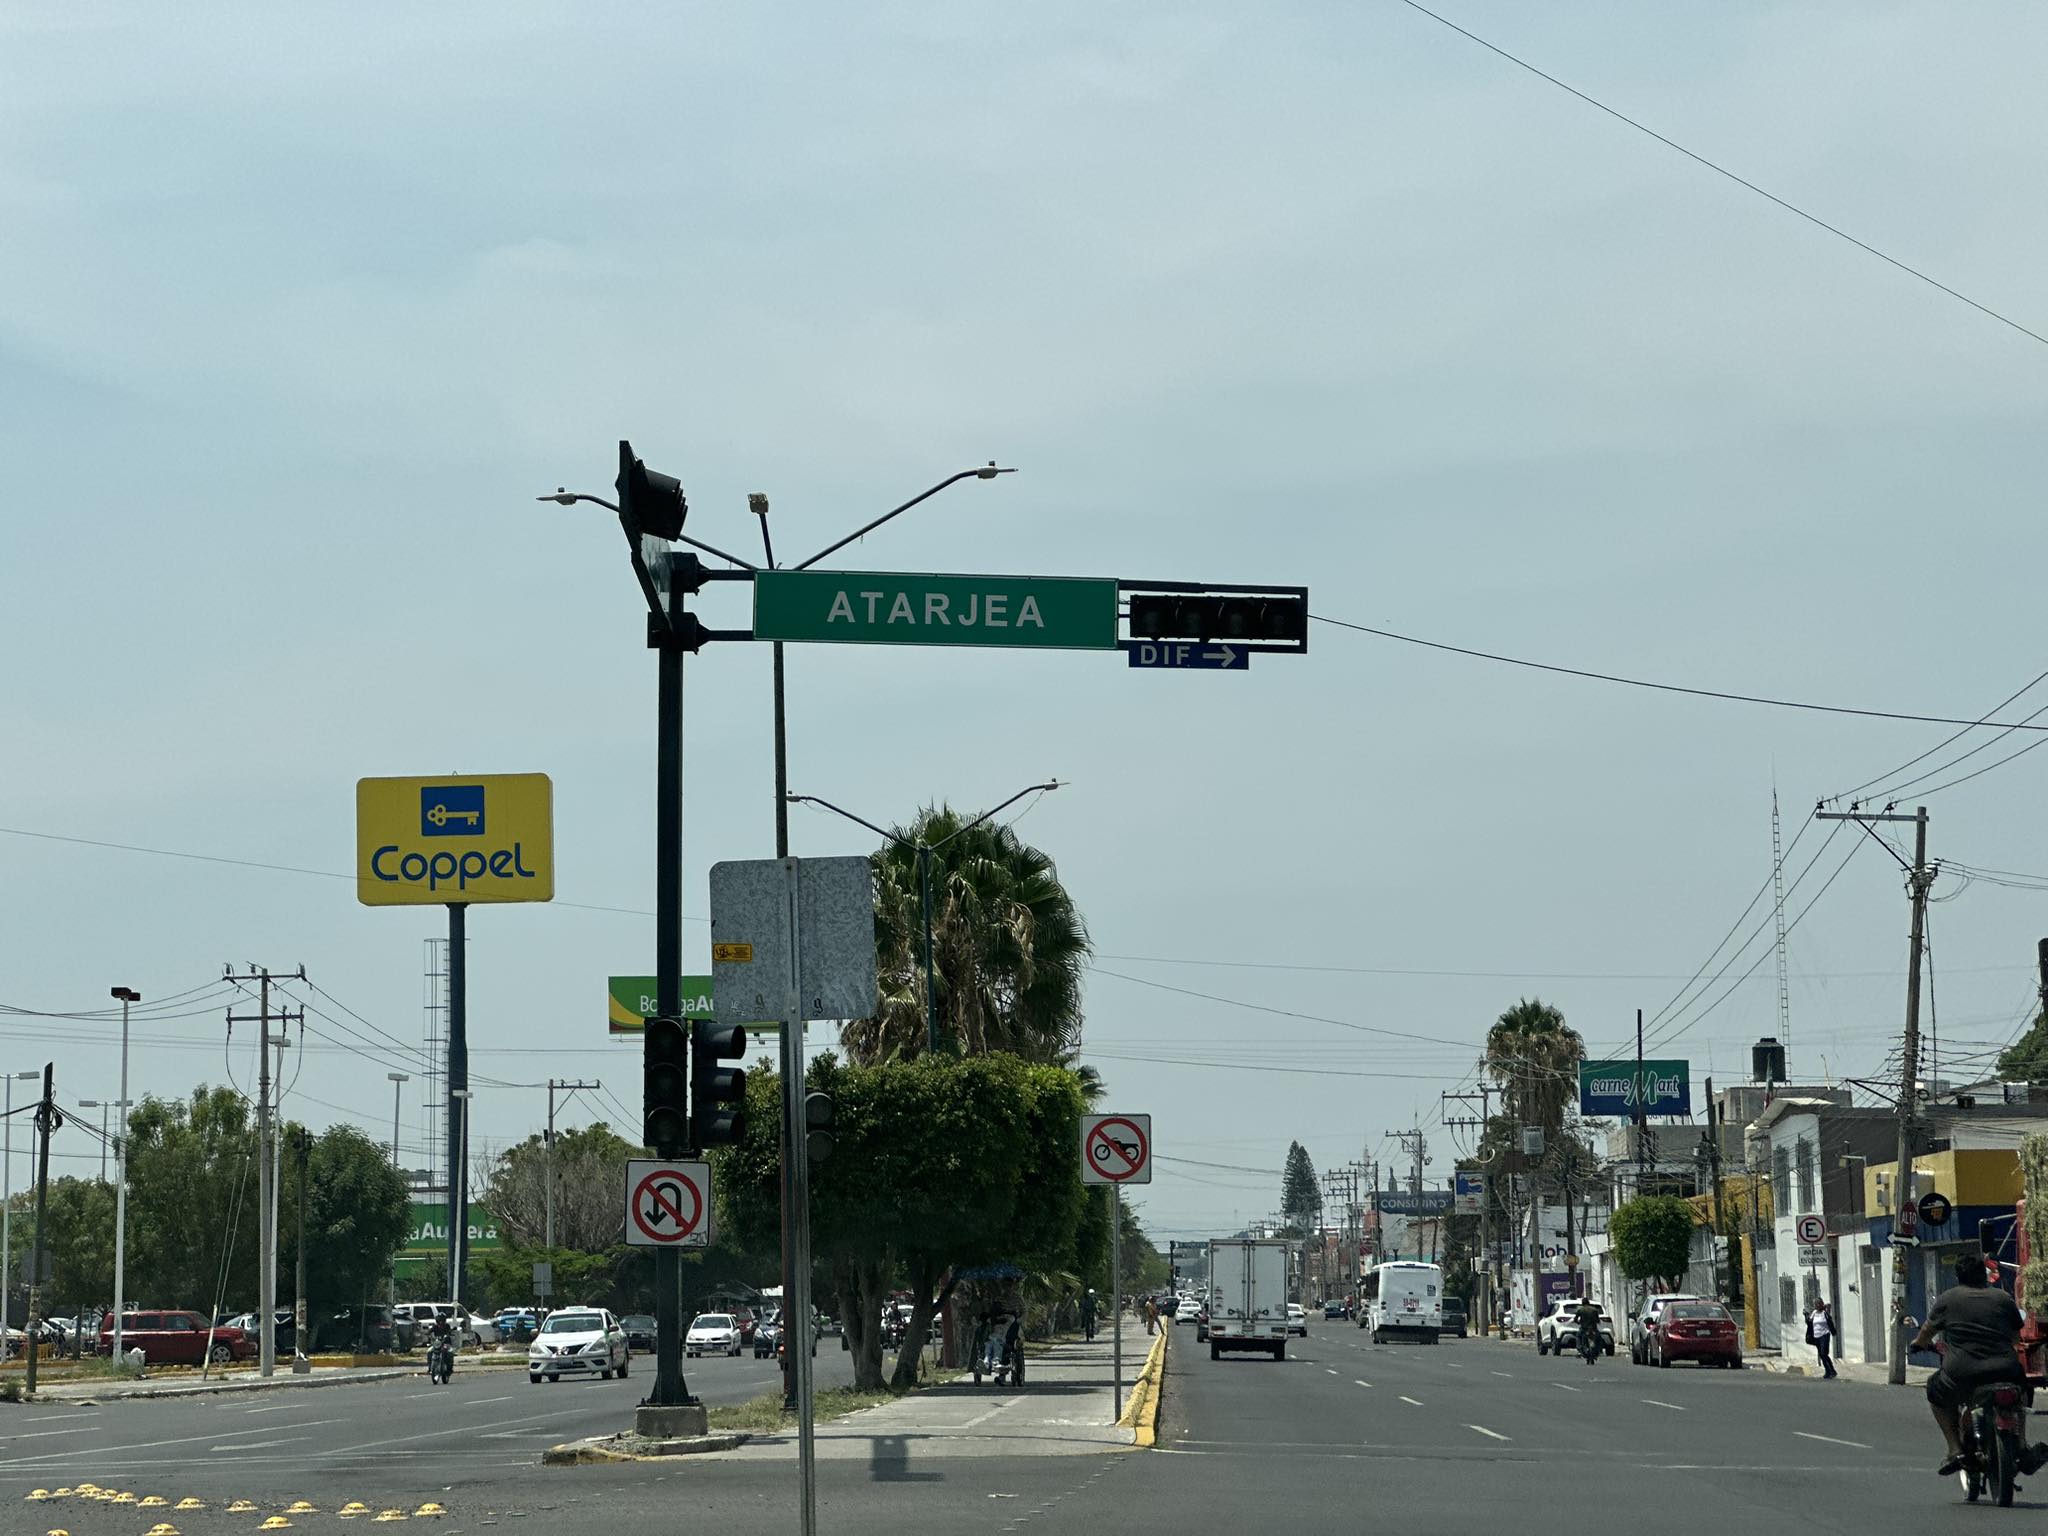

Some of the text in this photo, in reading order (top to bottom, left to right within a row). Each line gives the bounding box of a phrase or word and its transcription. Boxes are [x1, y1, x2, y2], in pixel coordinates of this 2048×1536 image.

[826, 591, 1045, 628] ATARJEA
[1140, 644, 1190, 666] DIF
[371, 842, 535, 891] Coppel
[1901, 1211, 1917, 1225] ALTO
[1805, 1222, 1818, 1238] E
